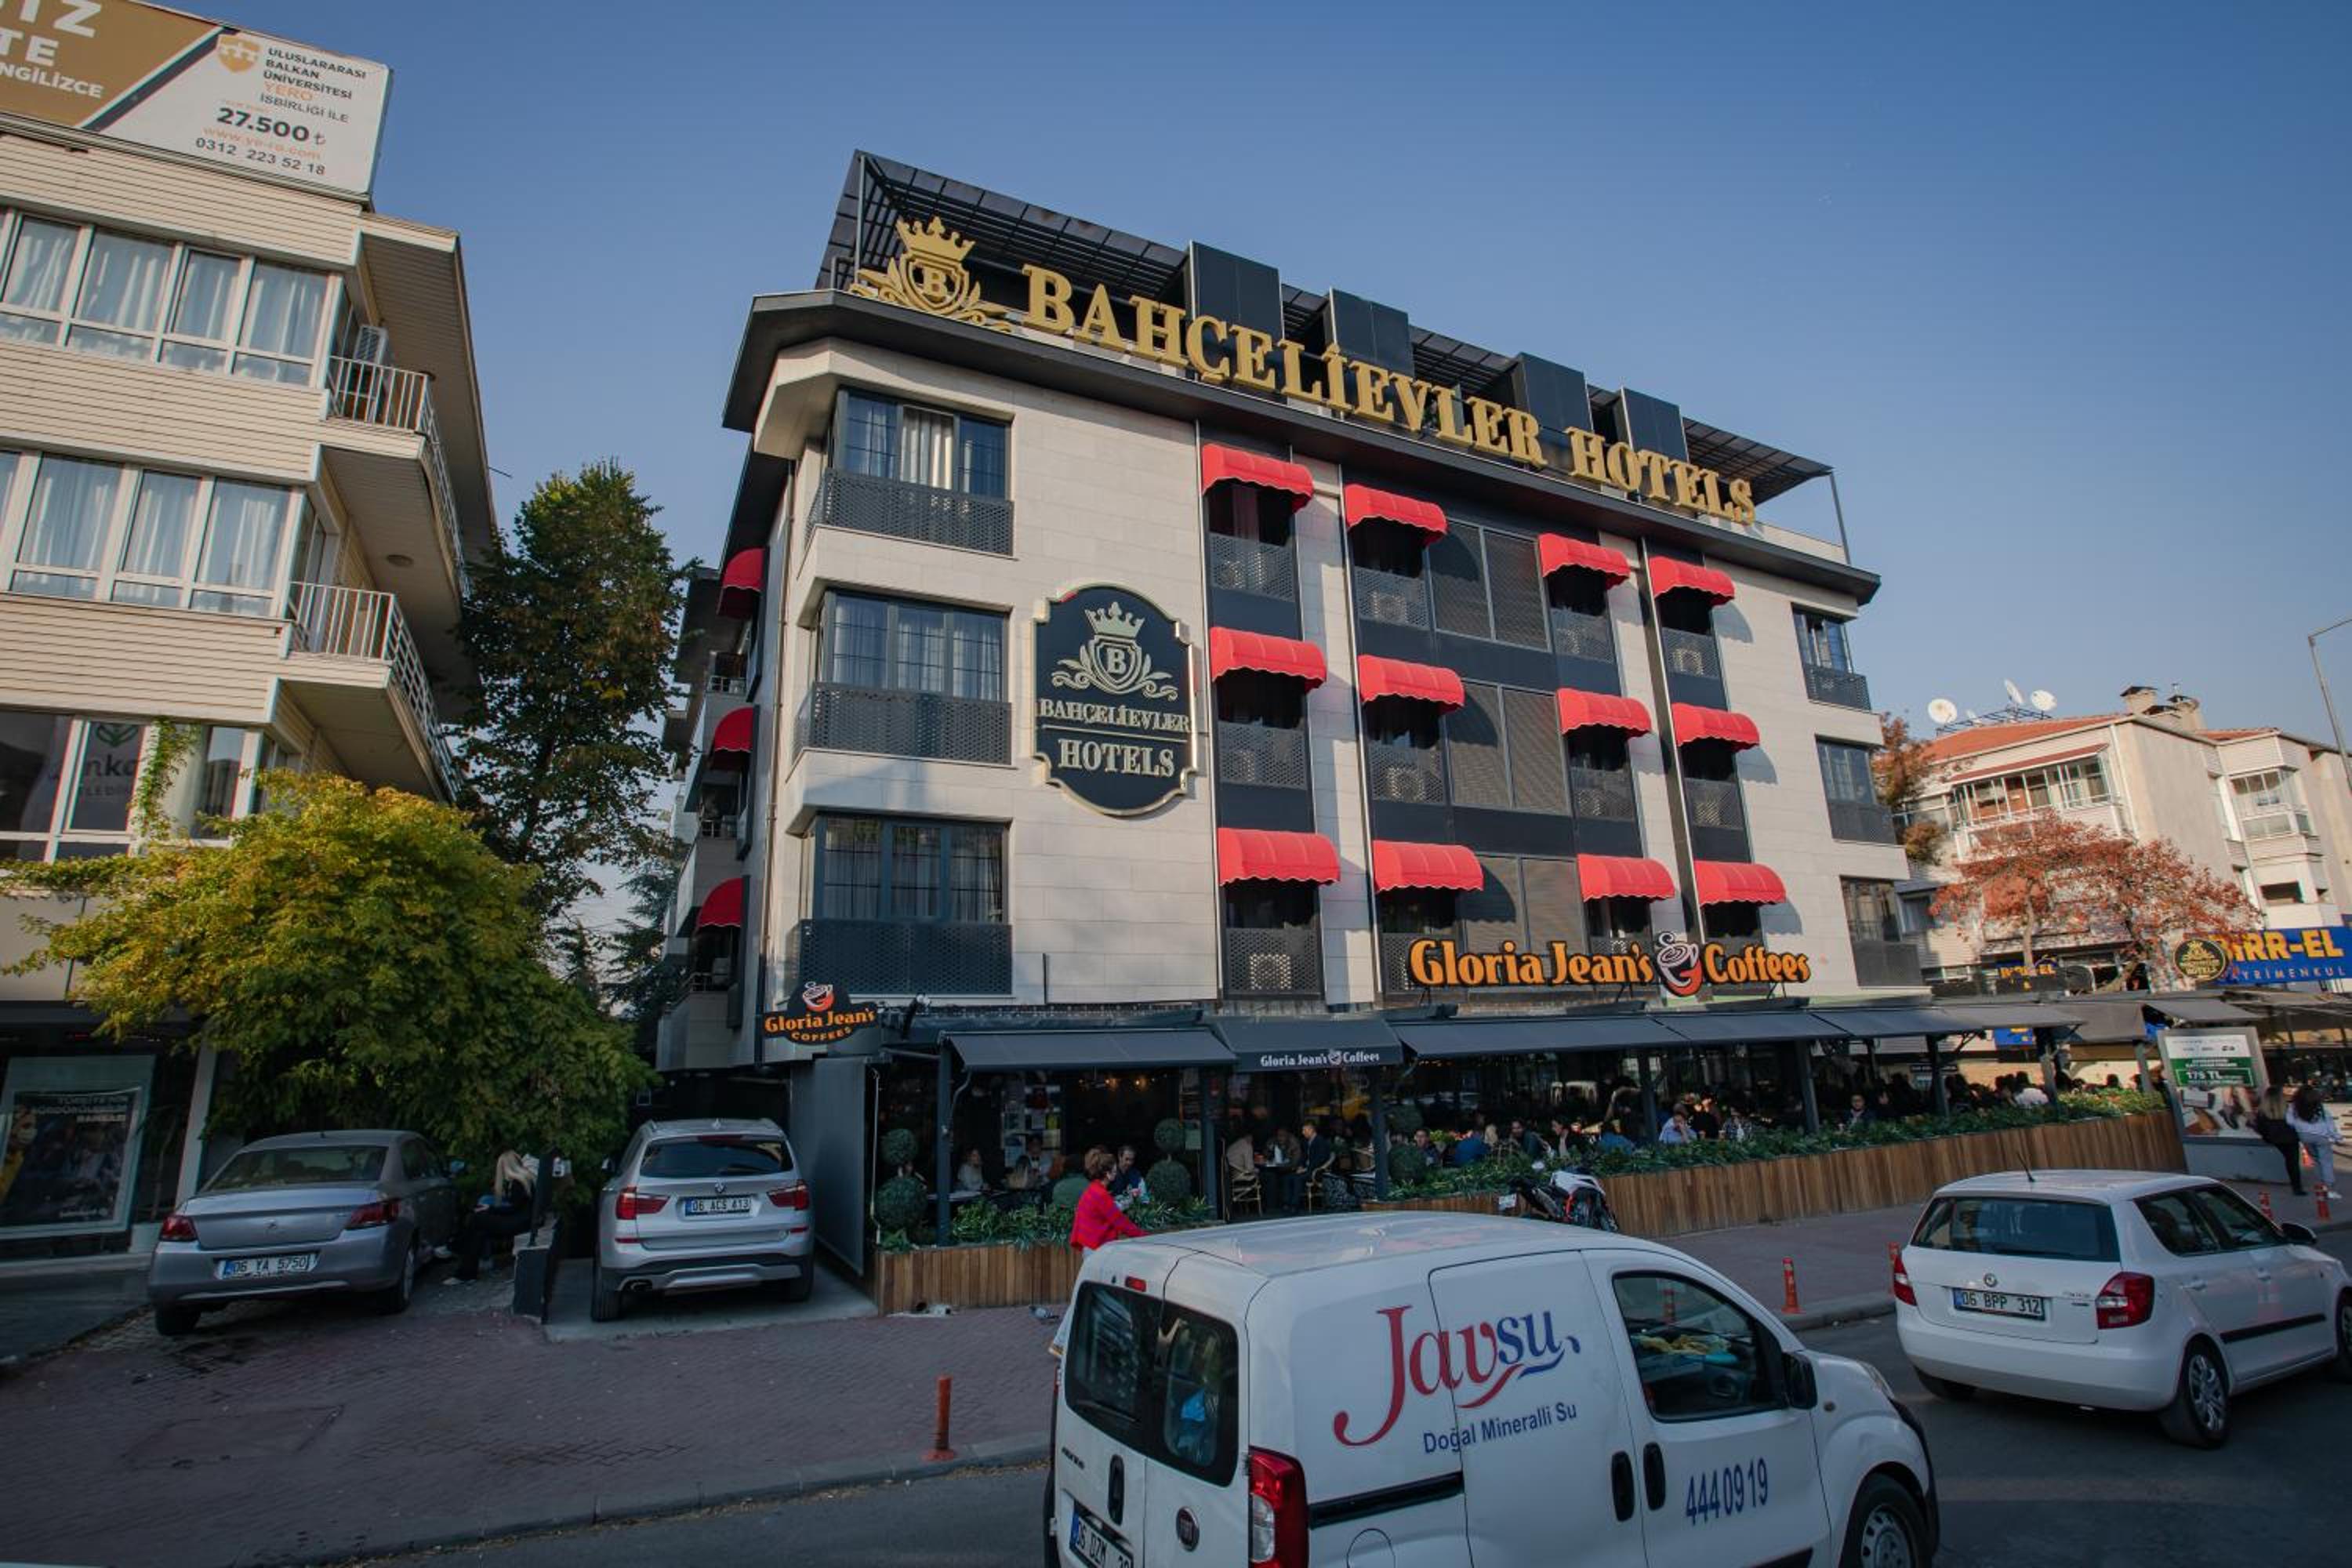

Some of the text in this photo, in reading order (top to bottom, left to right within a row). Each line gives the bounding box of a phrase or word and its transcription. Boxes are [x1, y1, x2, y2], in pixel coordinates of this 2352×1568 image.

[266, 60, 319, 79] BALKAN
[216, 107, 310, 142] 27.500
[196, 137, 326, 176] 0312 223 52 18
[922, 267, 950, 299] B
[1023, 263, 1755, 525] BAHÇELİEVLER HOTELS
[1106, 648, 1127, 674] B
[1058, 739, 1175, 777] HOTELS
[1410, 938, 1812, 985] Gloria Jean's Coffees
[764, 1007, 877, 1033] Gloria Jean's
[1260, 1054, 1295, 1067] Gloria
[1963, 1291, 2041, 1314] 06 BPP 312
[1423, 1402, 1577, 1454] Doğal Mineralli Su
